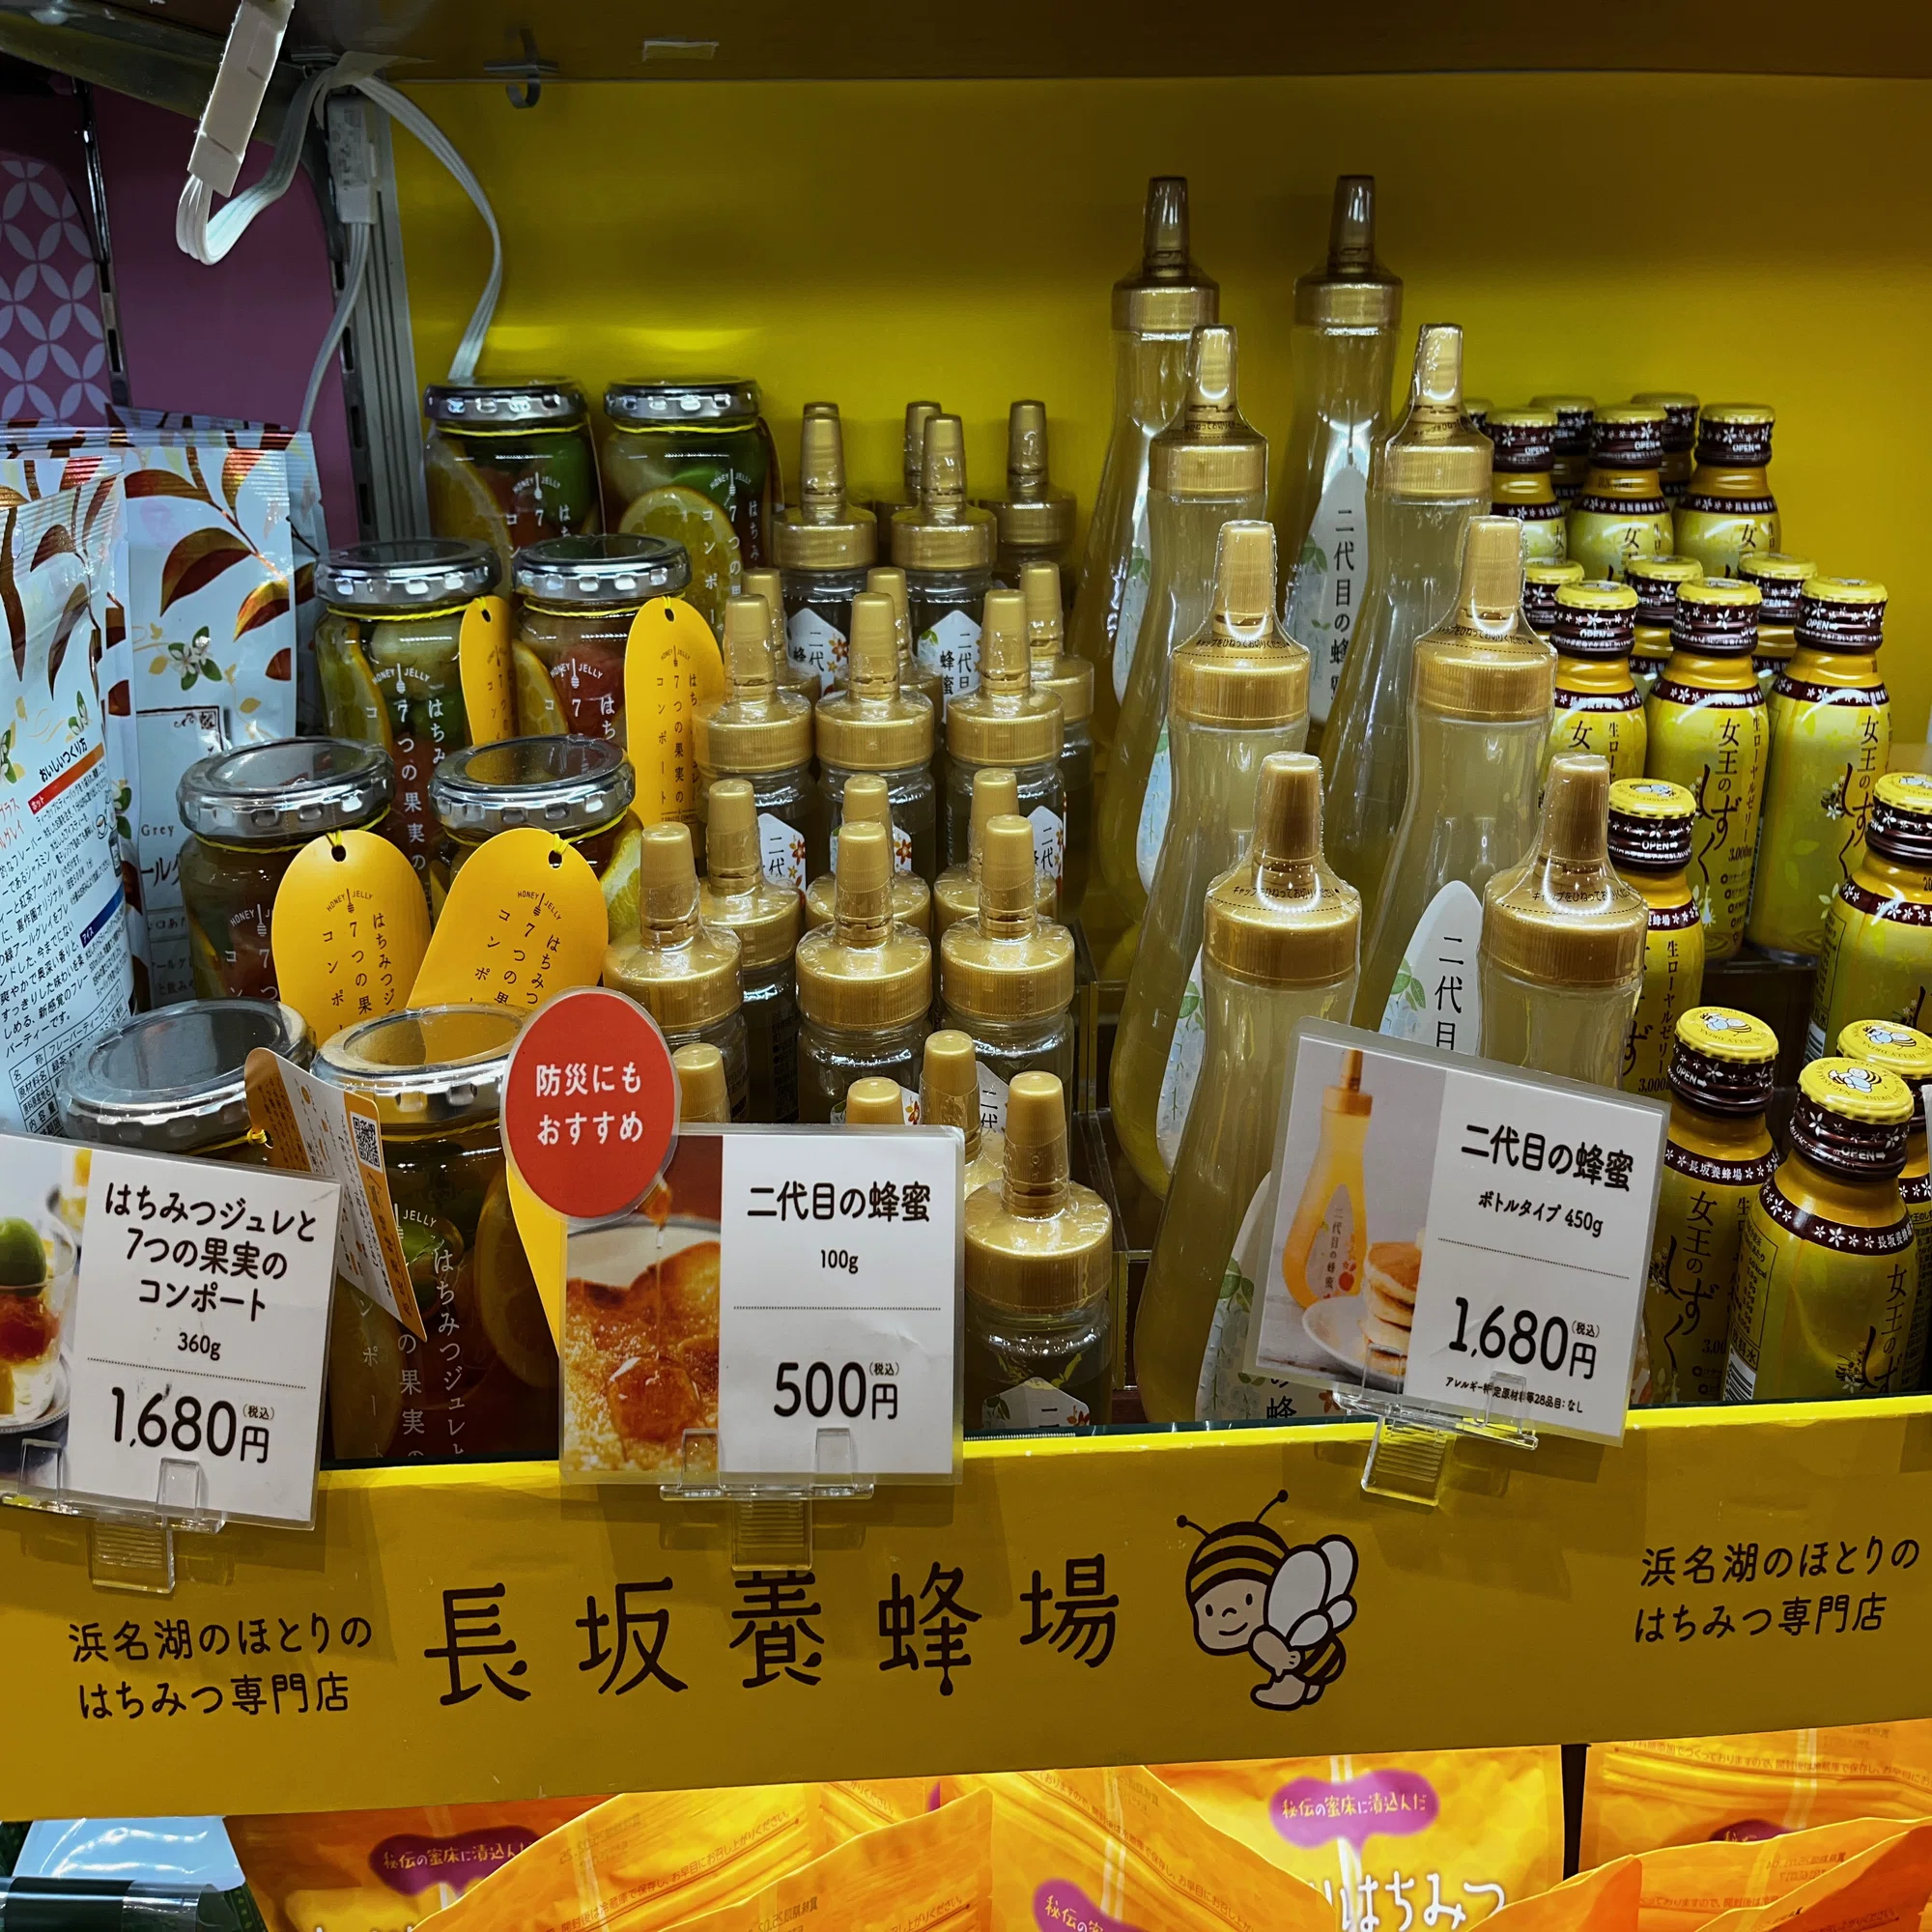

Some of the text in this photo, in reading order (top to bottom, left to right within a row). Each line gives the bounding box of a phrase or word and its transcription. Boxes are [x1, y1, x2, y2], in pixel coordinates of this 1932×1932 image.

[1732, 443, 1756, 453] OPEN
[535, 509, 544, 526] 7
[1806, 618, 1830, 630] OPEN
[404, 666, 431, 683] JELLY
[578, 664, 604, 680] JELLY
[571, 698, 581, 718] 7
[657, 676, 668, 806] コンポート
[673, 675, 685, 804] 7つの果実の
[1568, 720, 1593, 750] 女
[39, 737, 89, 783] おいしいつくり方
[141, 824, 175, 838] Grey
[1641, 840, 1670, 851] OPEN
[768, 836, 785, 877] 二代
[230, 908, 256, 927] HONEY
[327, 890, 373, 912] HONEY JELLY
[517, 889, 561, 921] HONEY JELLY
[259, 948, 279, 1001] 7つ
[349, 921, 373, 1015] 7つの果
[373, 912, 396, 1012] はちみつジ
[526, 933, 561, 1006] はちみつ
[1434, 935, 1465, 1051] 二代目
[1657, 939, 1680, 1074] 生ローヤルゼリー
[536, 1061, 641, 1097] 防災にも
[1676, 1064, 1698, 1085] OPEN
[537, 1110, 643, 1146] おすすめ
[1461, 1123, 1635, 1193] 二代目の蜂蜜
[1689, 1159, 1743, 1181] 長坂養蜂場
[1840, 1145, 1876, 1161] OPEN
[106, 1182, 317, 1242] はちみつジュレと
[403, 1208, 438, 1228] JELLY
[747, 1179, 932, 1223] 二代目の蜂蜜
[1478, 1190, 1605, 1239] ボトルタイプ 450g
[127, 1227, 289, 1279] 7つの果実の
[820, 1249, 860, 1274] 100g
[139, 1279, 266, 1322] コンポート
[178, 1331, 221, 1361] 360g
[1639, 1534, 1920, 1587] 浜名湖のほとりの
[423, 1552, 1121, 1706] 長坂養蜂場
[1634, 1591, 1888, 1643] はちみつ専門店
[68, 1611, 373, 1663] 浜名湖のほとりの
[78, 1671, 350, 1719] はちみつ専門店
[1281, 1791, 1427, 1820] 秘伝の蜜床に漬込んだ
